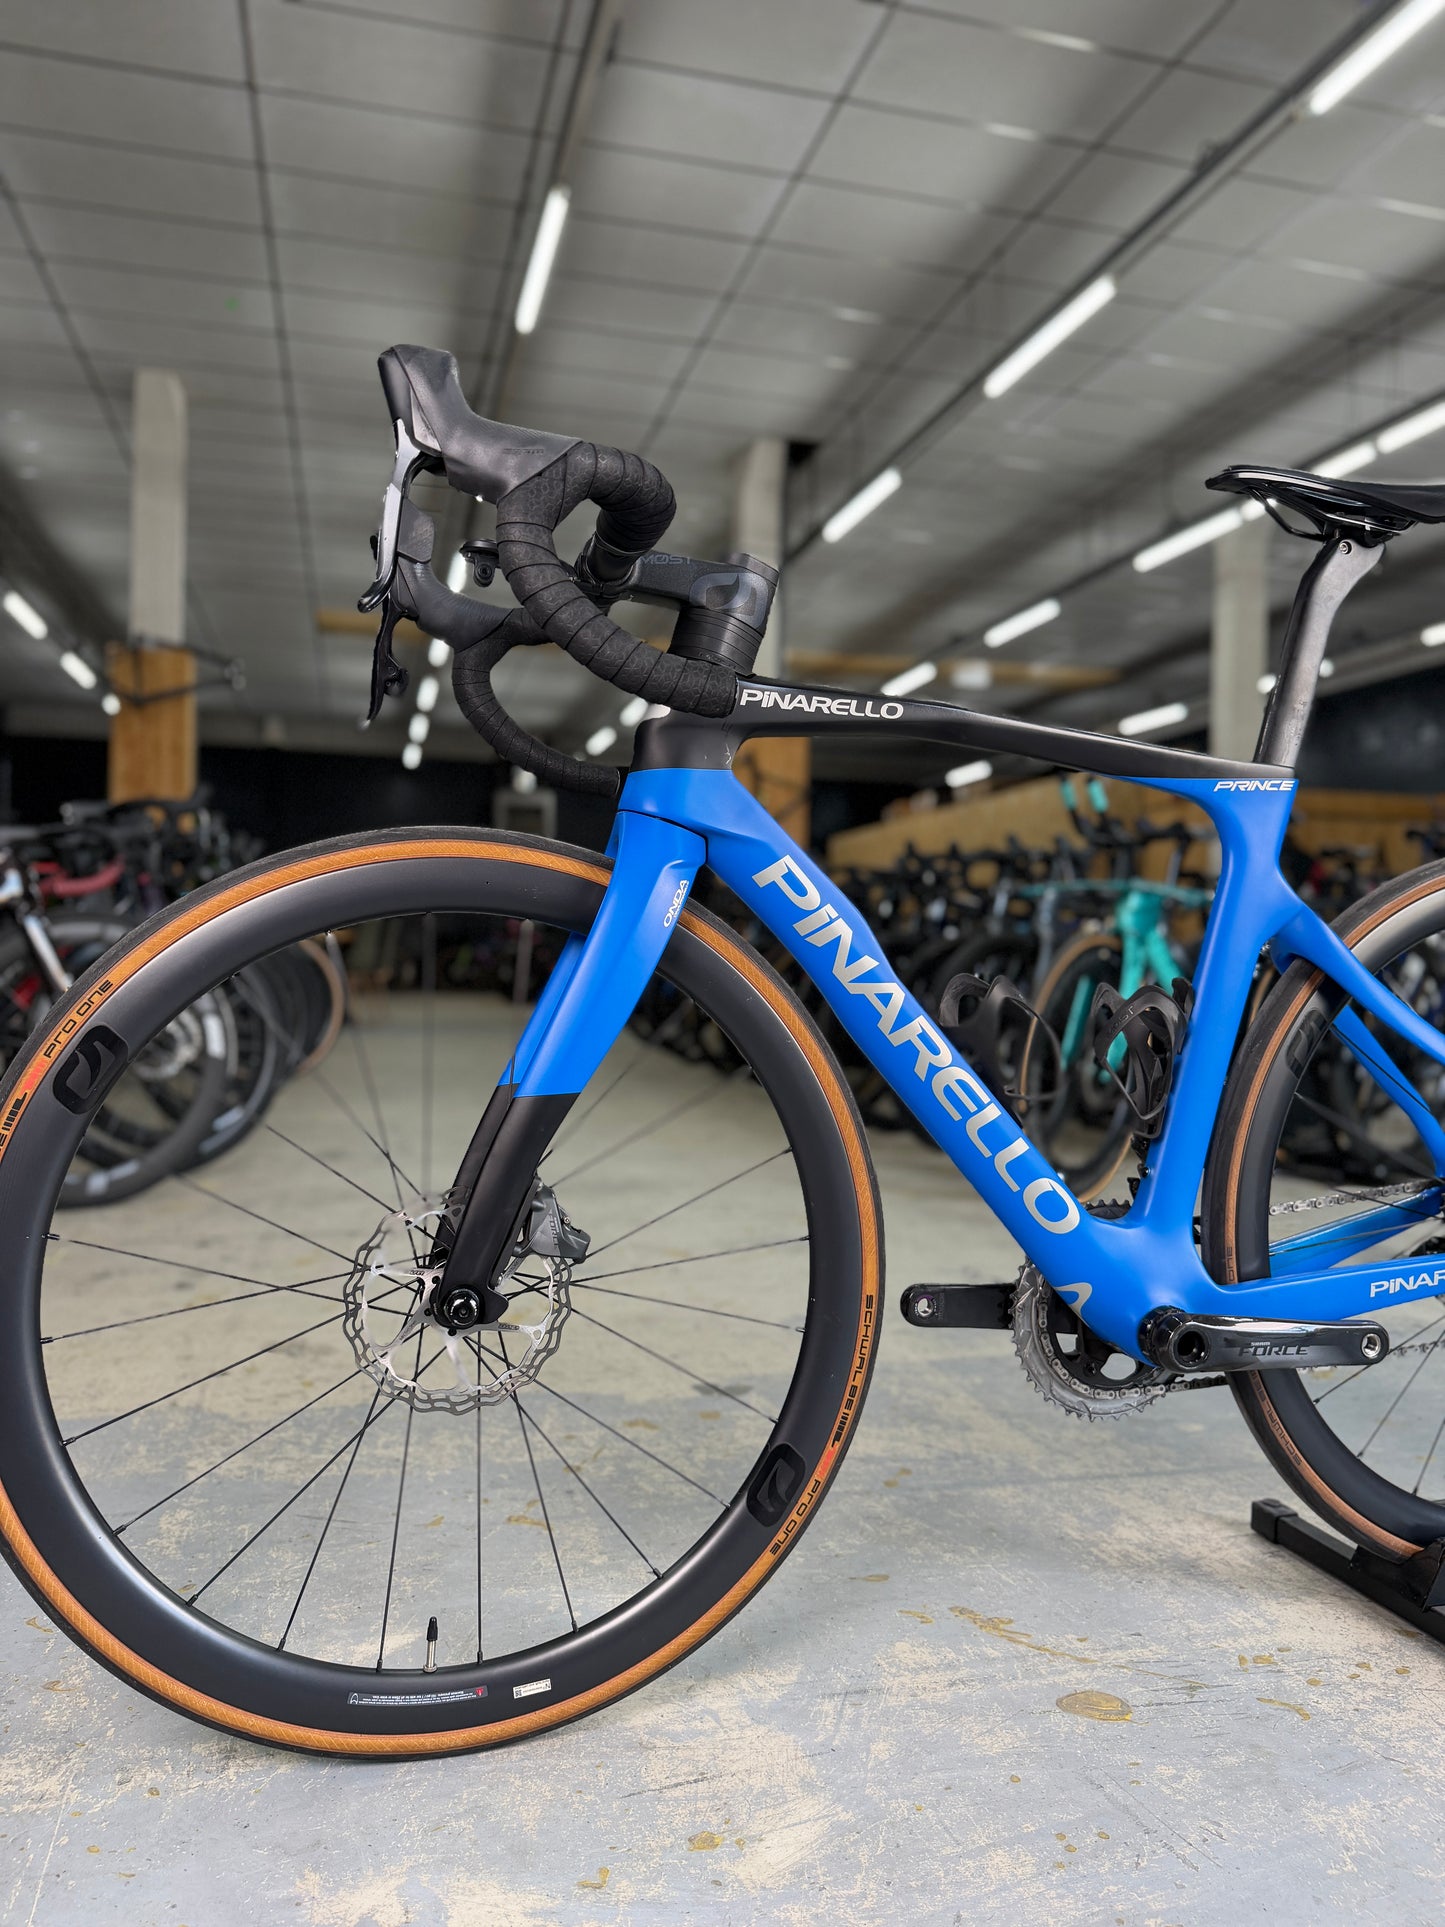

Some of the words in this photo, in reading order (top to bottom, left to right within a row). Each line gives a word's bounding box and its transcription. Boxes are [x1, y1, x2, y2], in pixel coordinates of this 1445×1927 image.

[639, 554, 692, 565] MOST
[740, 689, 904, 719] PINARELLO
[1213, 780, 1295, 792] PRINCE
[663, 879, 690, 928] ONDA
[43, 1018, 77, 1059] PRO
[76, 979, 114, 1017] ONE
[752, 854, 1081, 1235] PINARELLO
[1226, 1246, 1234, 1282] ONE
[843, 1294, 874, 1411] SCHWALBE
[1238, 1344, 1309, 1357] FORCE
[1253, 1376, 1303, 1467] SCHWALBE
[797, 1478, 821, 1518] PRO
[768, 1518, 799, 1556] ONE
